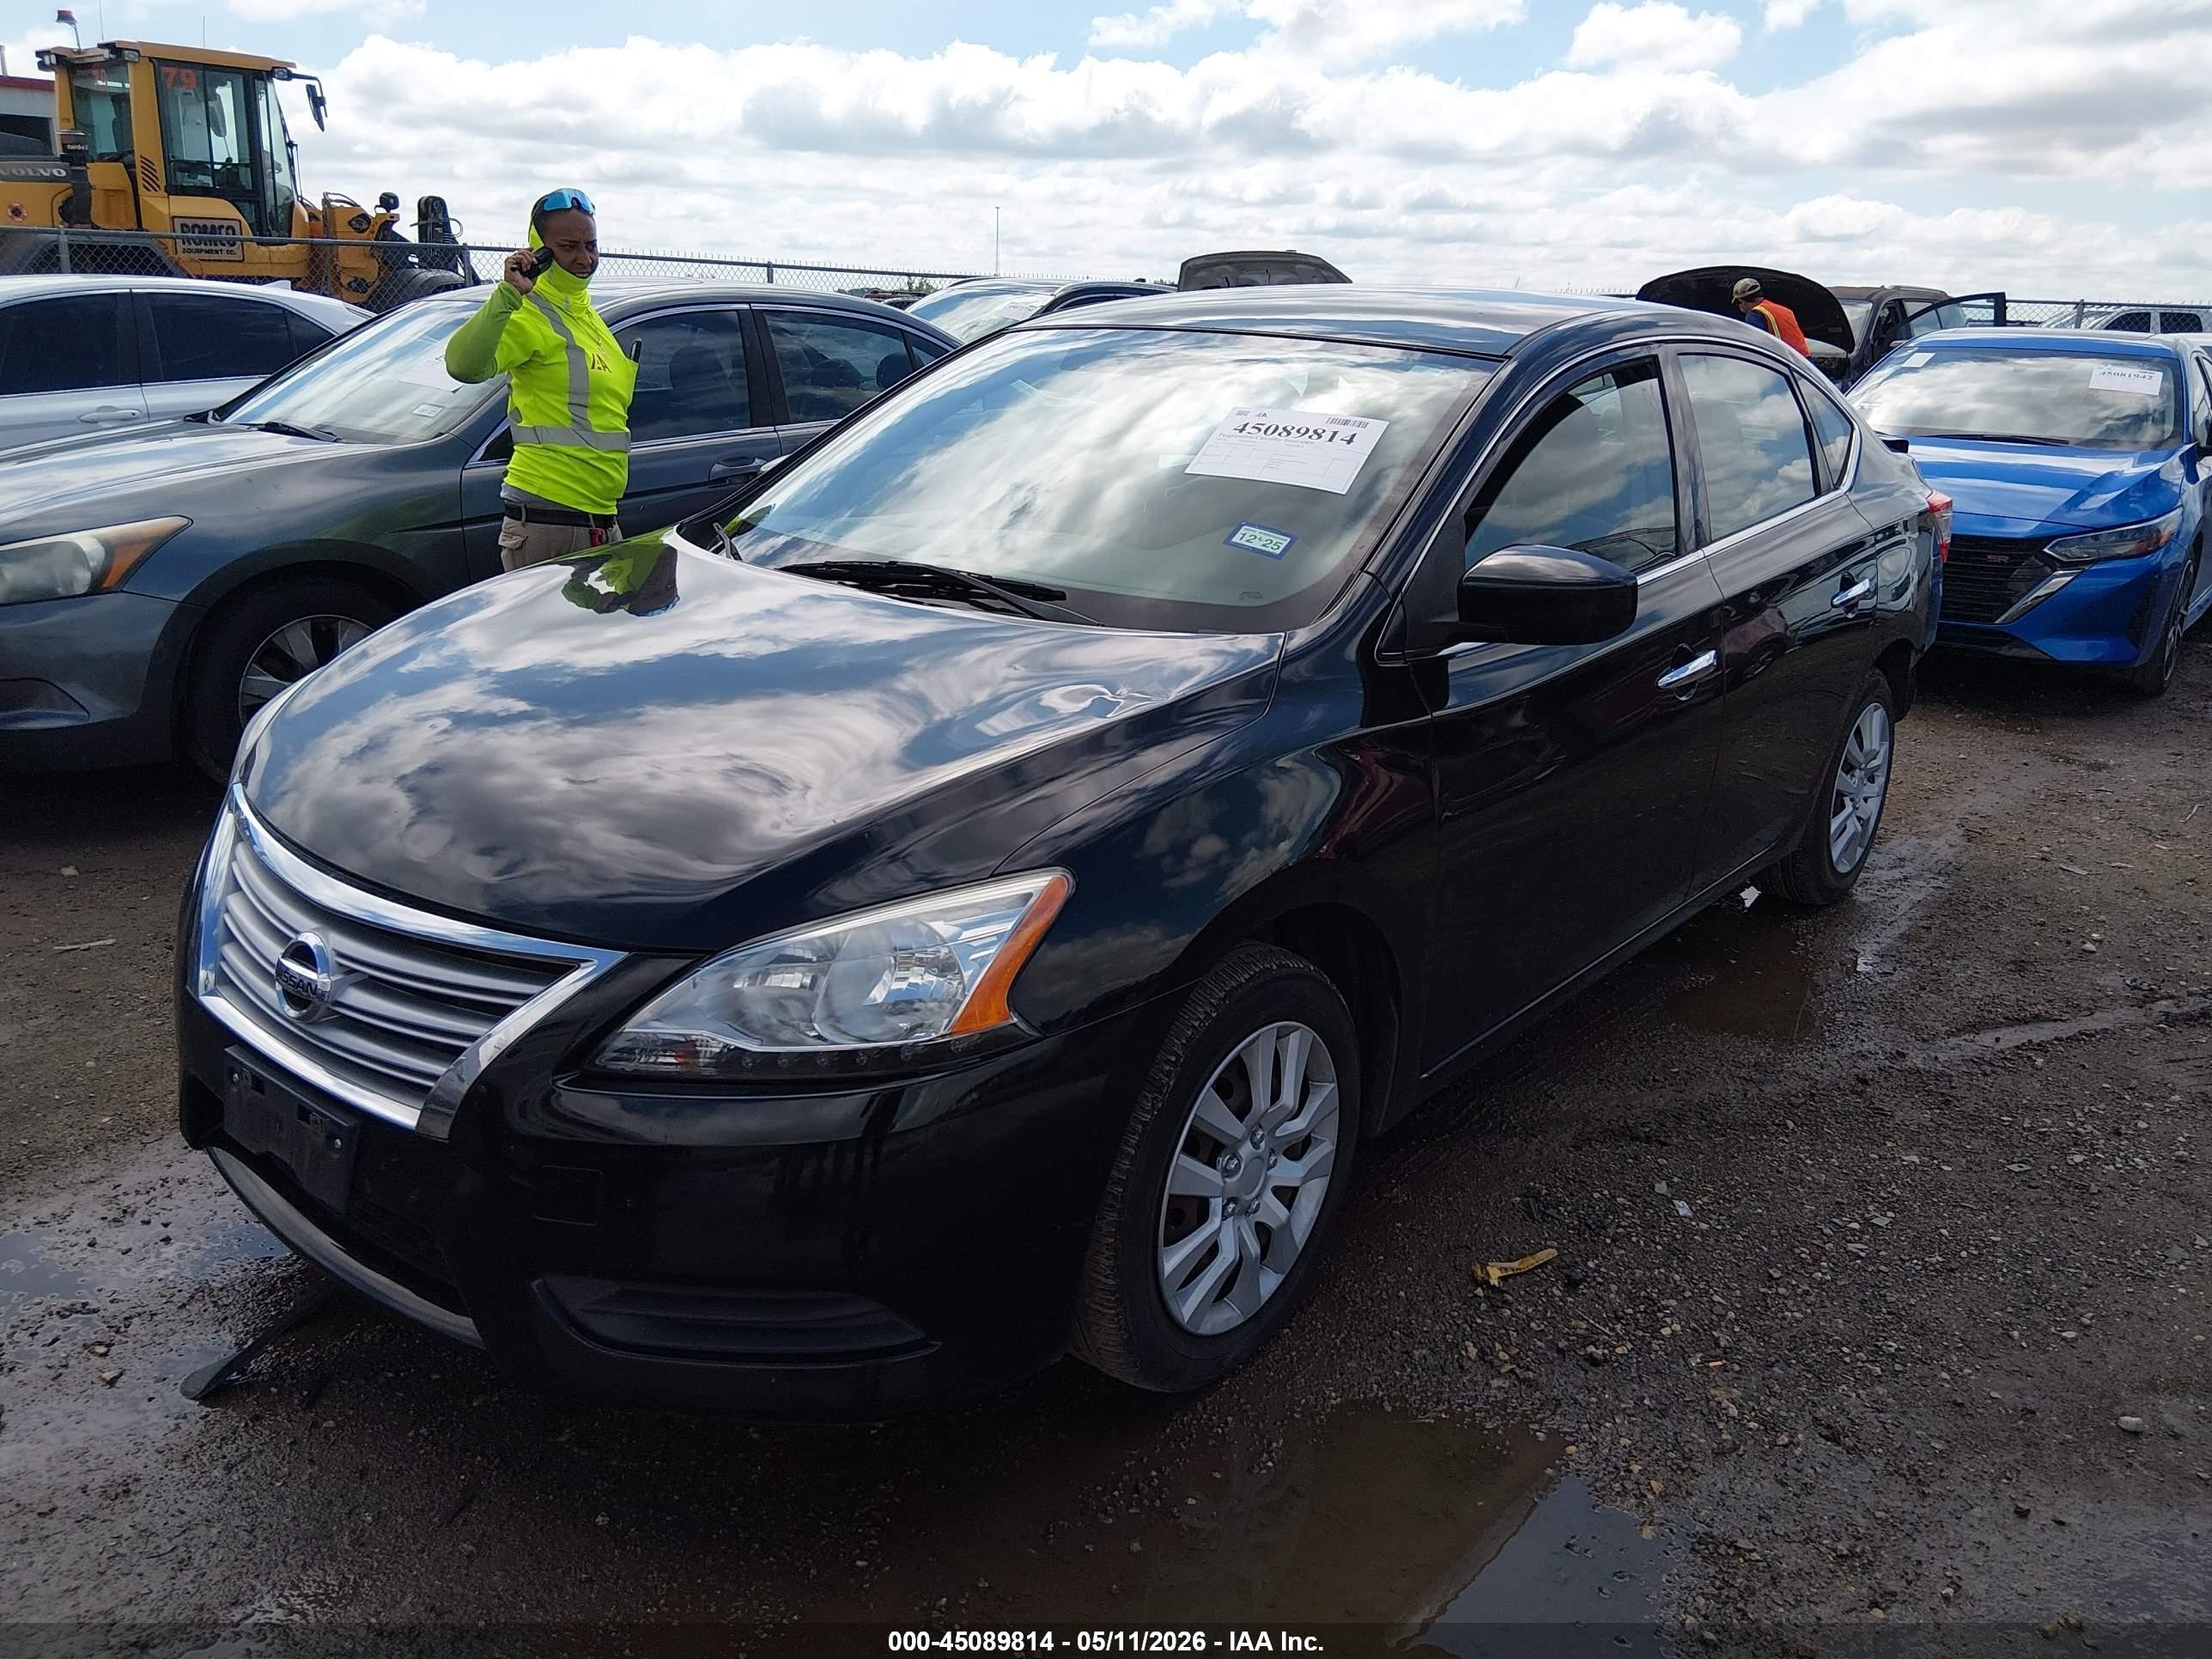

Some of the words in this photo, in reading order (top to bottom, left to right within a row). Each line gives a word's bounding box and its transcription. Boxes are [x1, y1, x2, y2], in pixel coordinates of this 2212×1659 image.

[161, 66, 198, 90] 79
[179, 223, 237, 247] ROMCO
[1233, 421, 1358, 445] 45089814
